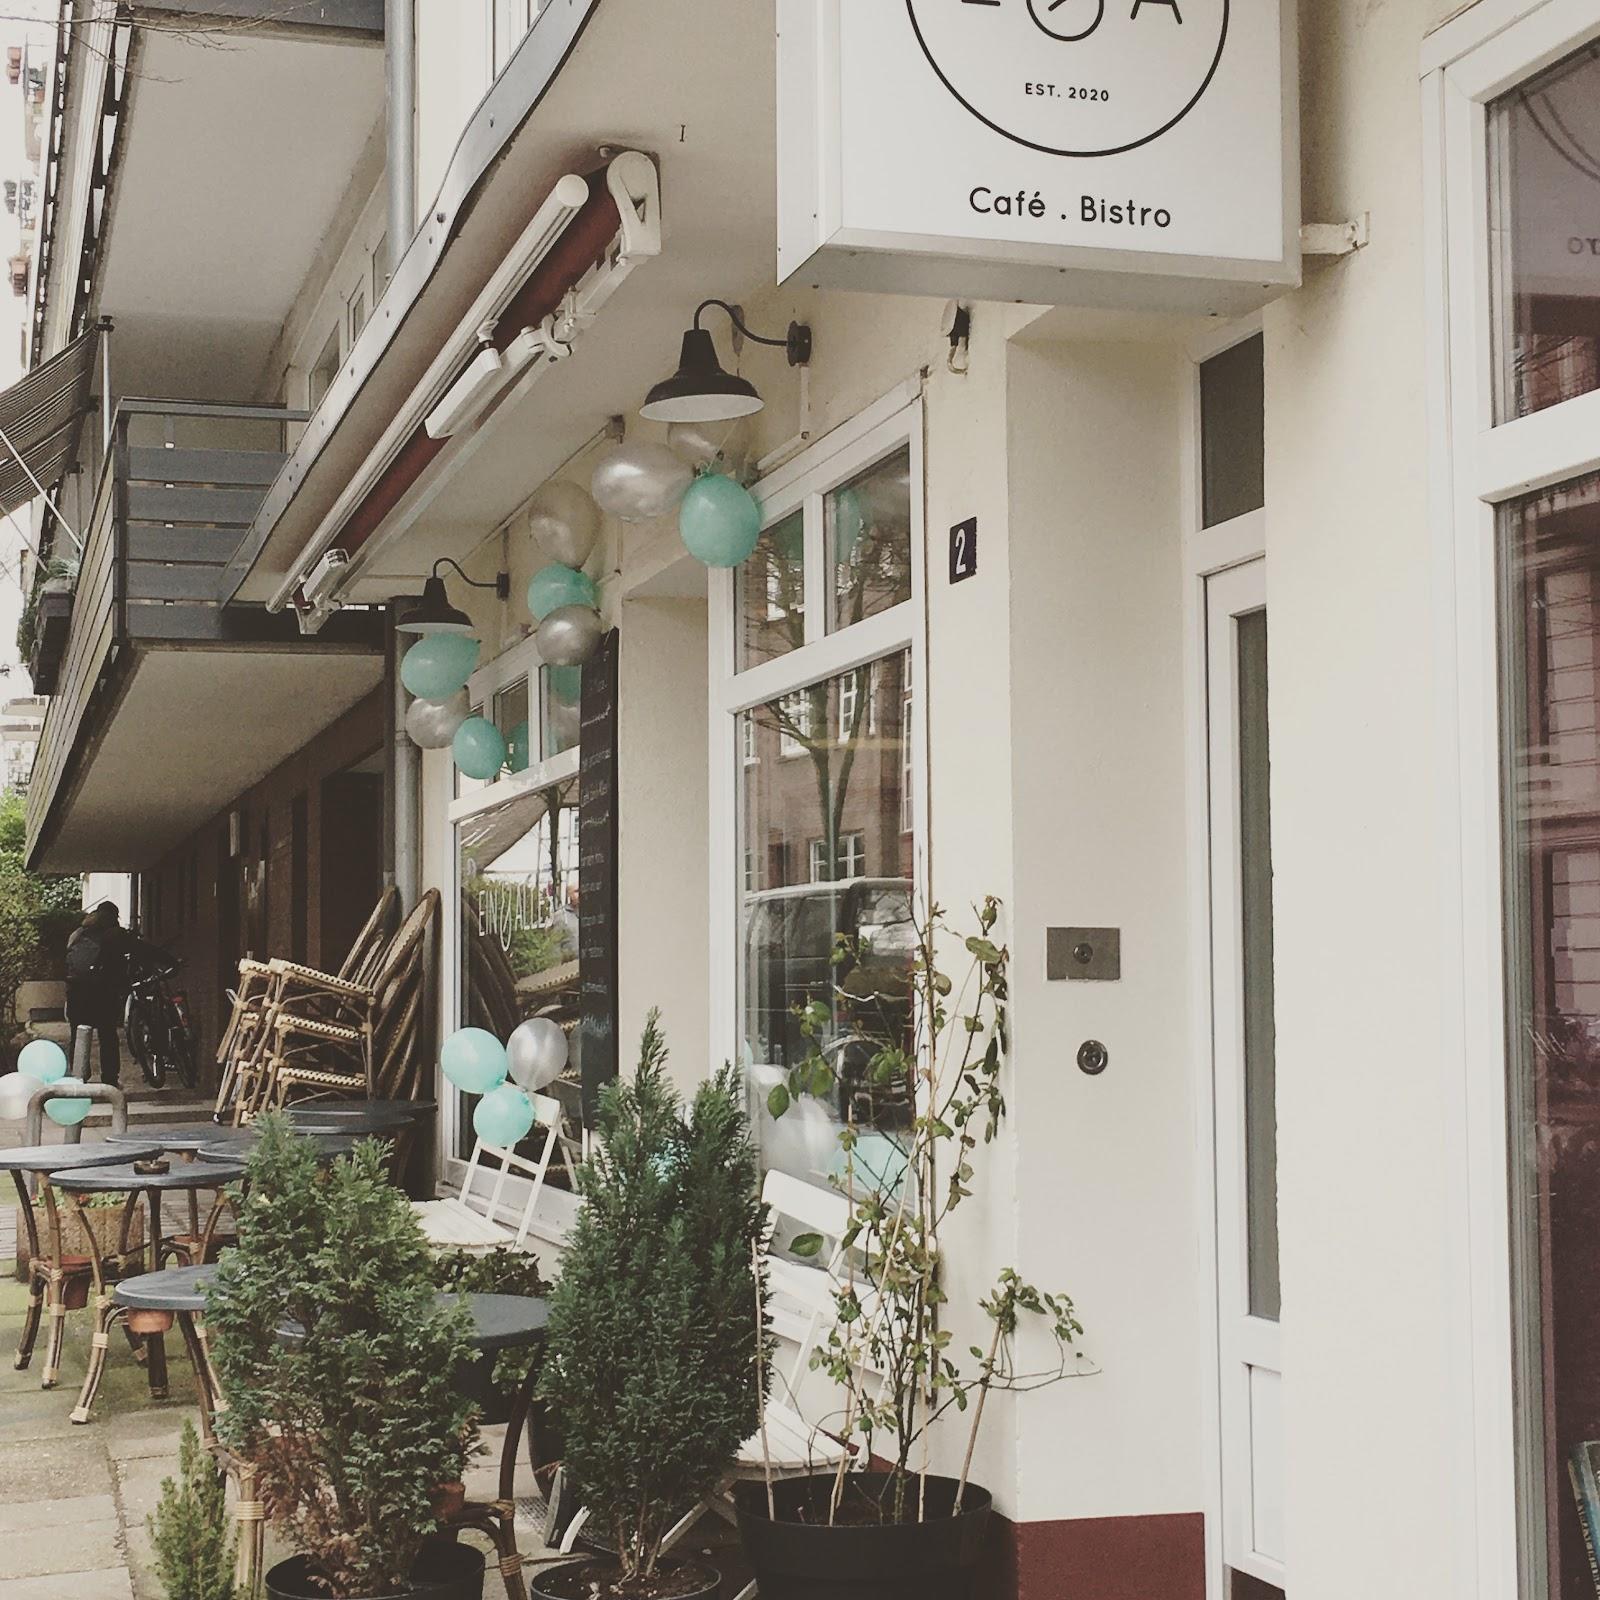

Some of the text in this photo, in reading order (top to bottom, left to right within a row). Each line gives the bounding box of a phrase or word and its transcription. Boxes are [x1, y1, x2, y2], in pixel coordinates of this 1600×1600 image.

[1025, 82, 1109, 102] EST. 2020
[969, 186, 1046, 218] Café
[1080, 195, 1171, 228] Bistro
[954, 527, 967, 575] 2
